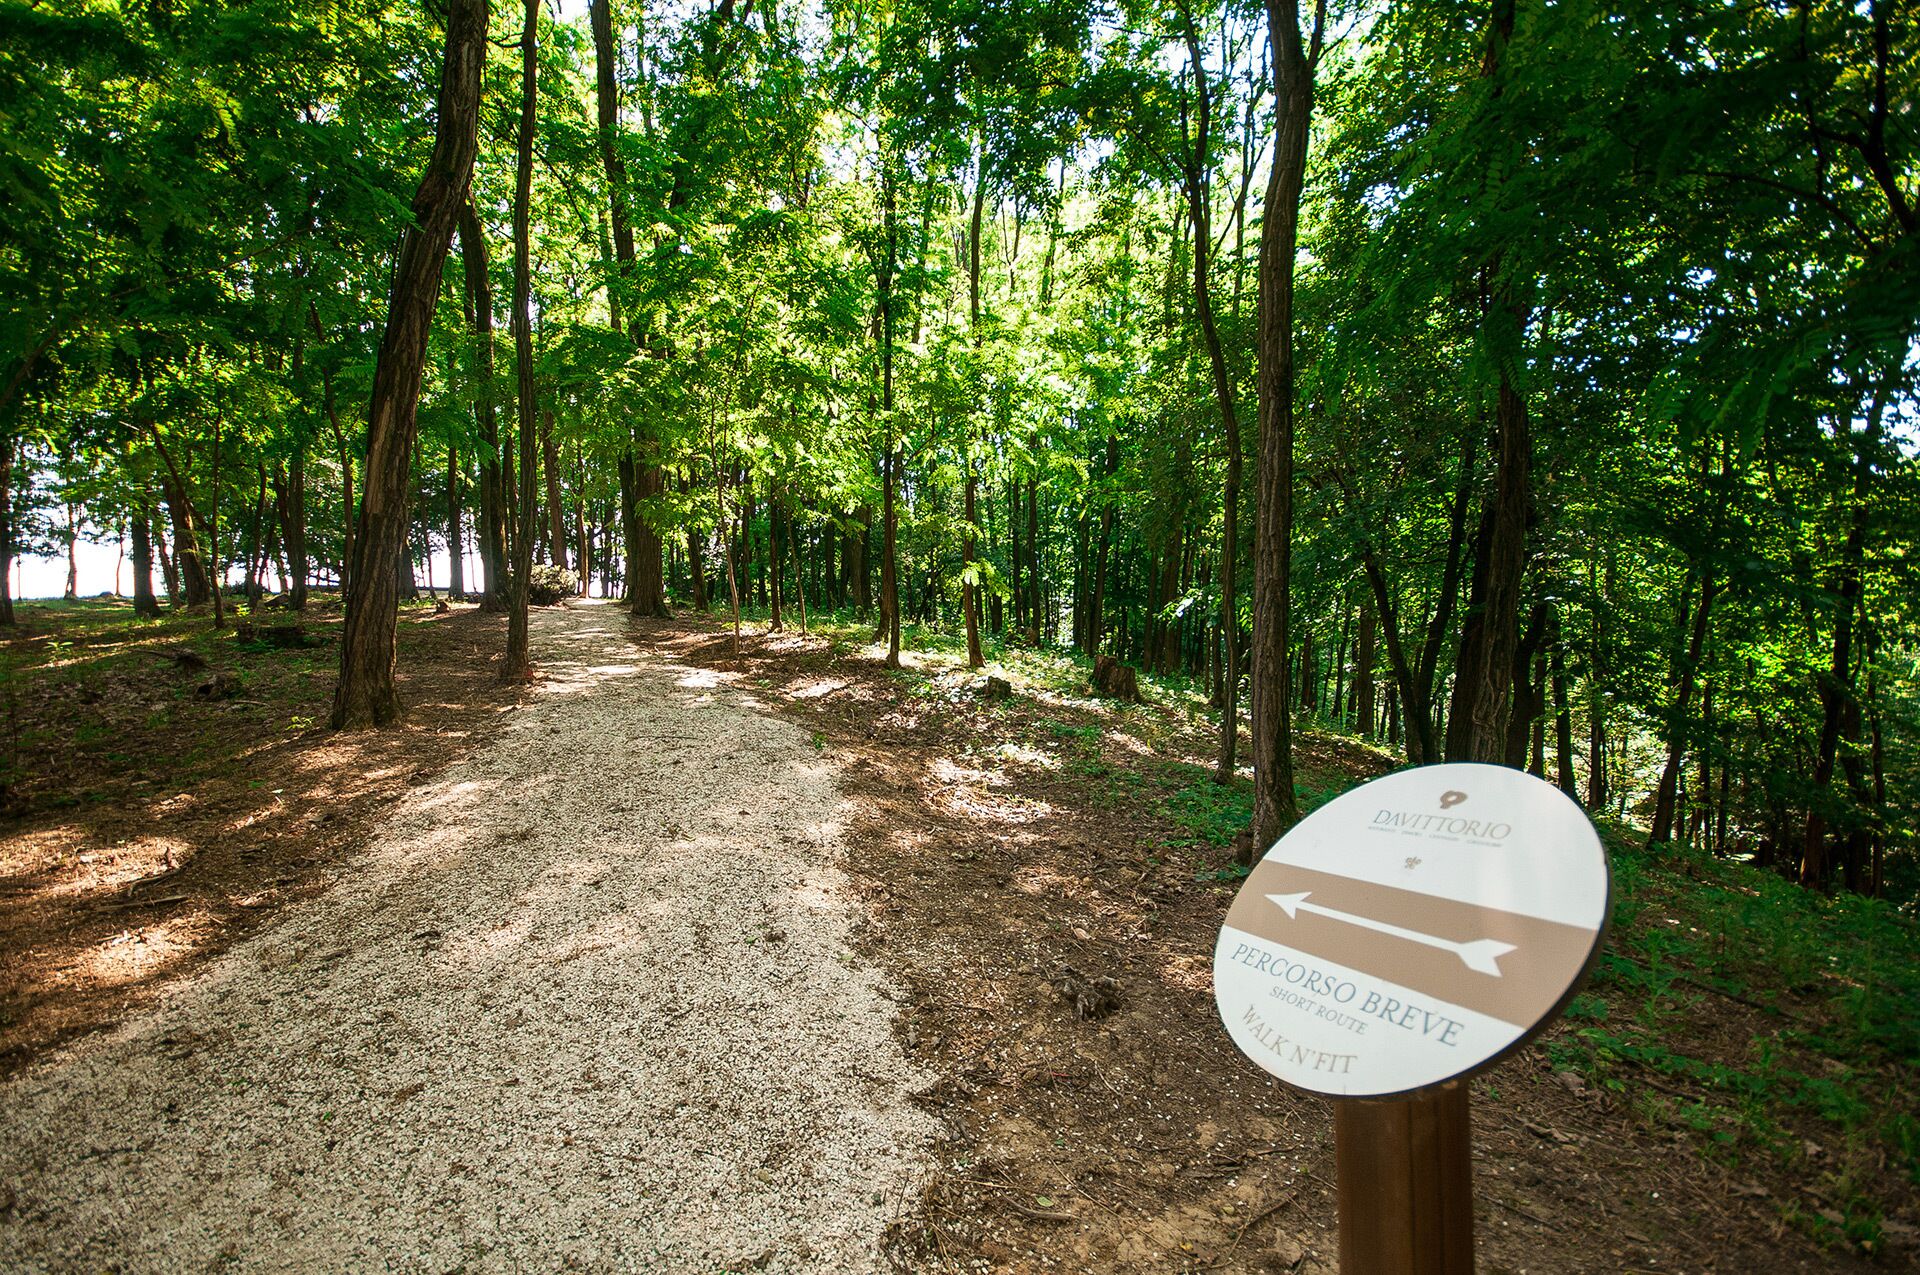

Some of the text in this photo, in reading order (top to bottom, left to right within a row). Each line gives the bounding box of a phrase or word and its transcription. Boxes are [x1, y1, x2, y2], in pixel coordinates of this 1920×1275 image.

[1373, 809, 1512, 840] DAVITTORIO
[1230, 943, 1465, 1047] PERCORSO BREVE
[1269, 985, 1369, 1036] SHORT ROUTE
[1242, 1003, 1289, 1057] WALK
